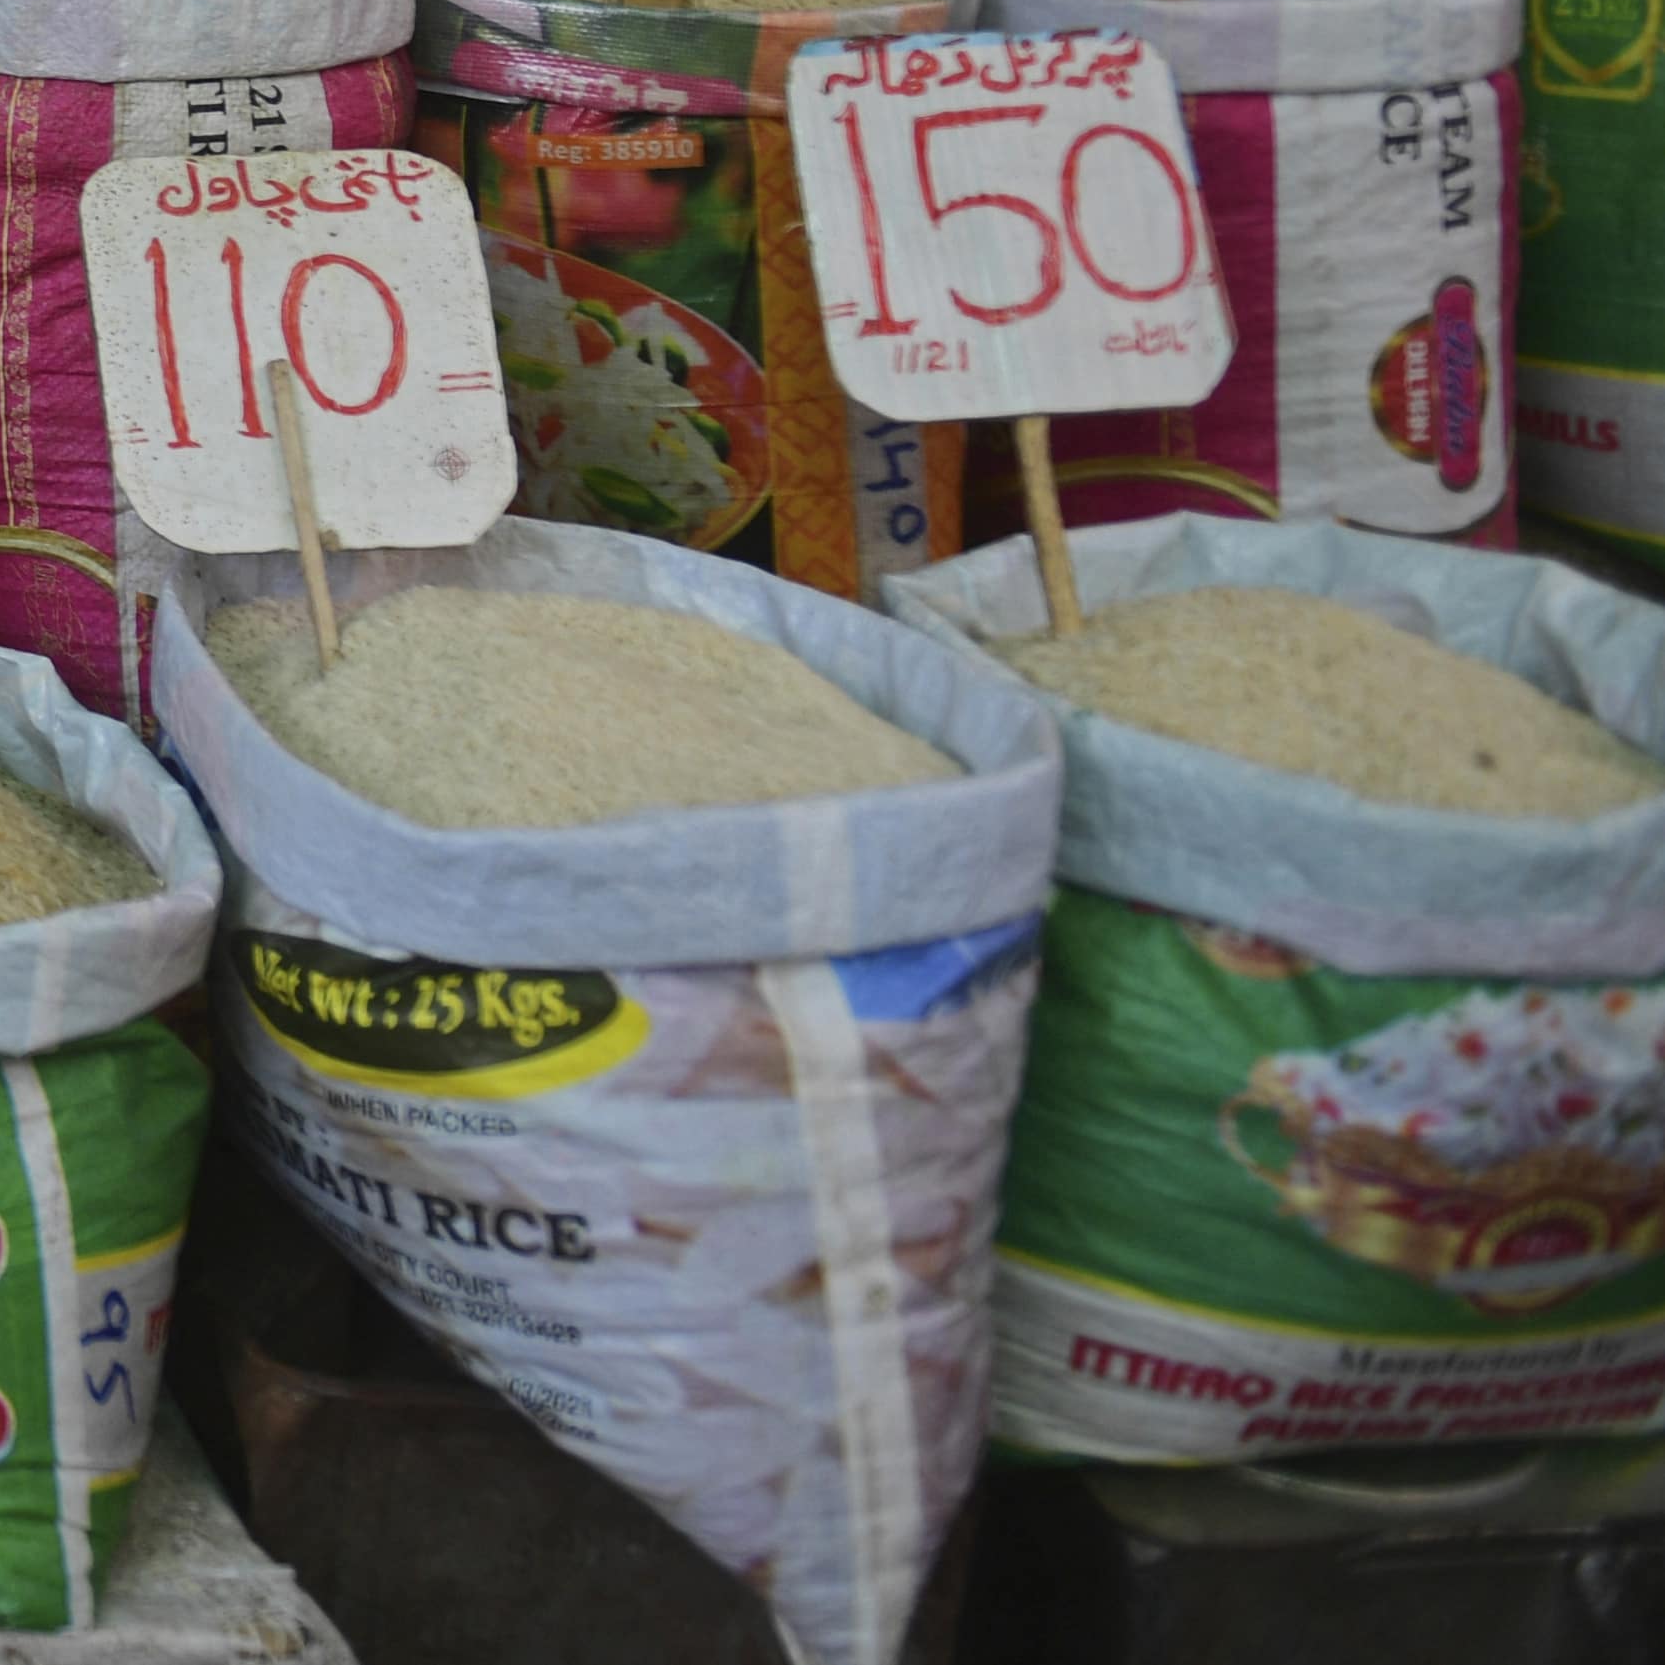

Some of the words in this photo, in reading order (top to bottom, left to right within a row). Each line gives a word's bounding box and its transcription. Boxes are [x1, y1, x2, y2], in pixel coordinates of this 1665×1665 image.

[538, 137, 594, 166] Reg:
[599, 137, 695, 164] 385910
[156, 157, 299, 229] چاول
[834, 101, 1197, 338] 150
[145, 237, 408, 450] 110
[892, 342, 970, 374] 1121
[408, 975, 466, 1033] 25
[474, 970, 582, 1049] Kgs.
[416, 1191, 597, 1263] RICE
